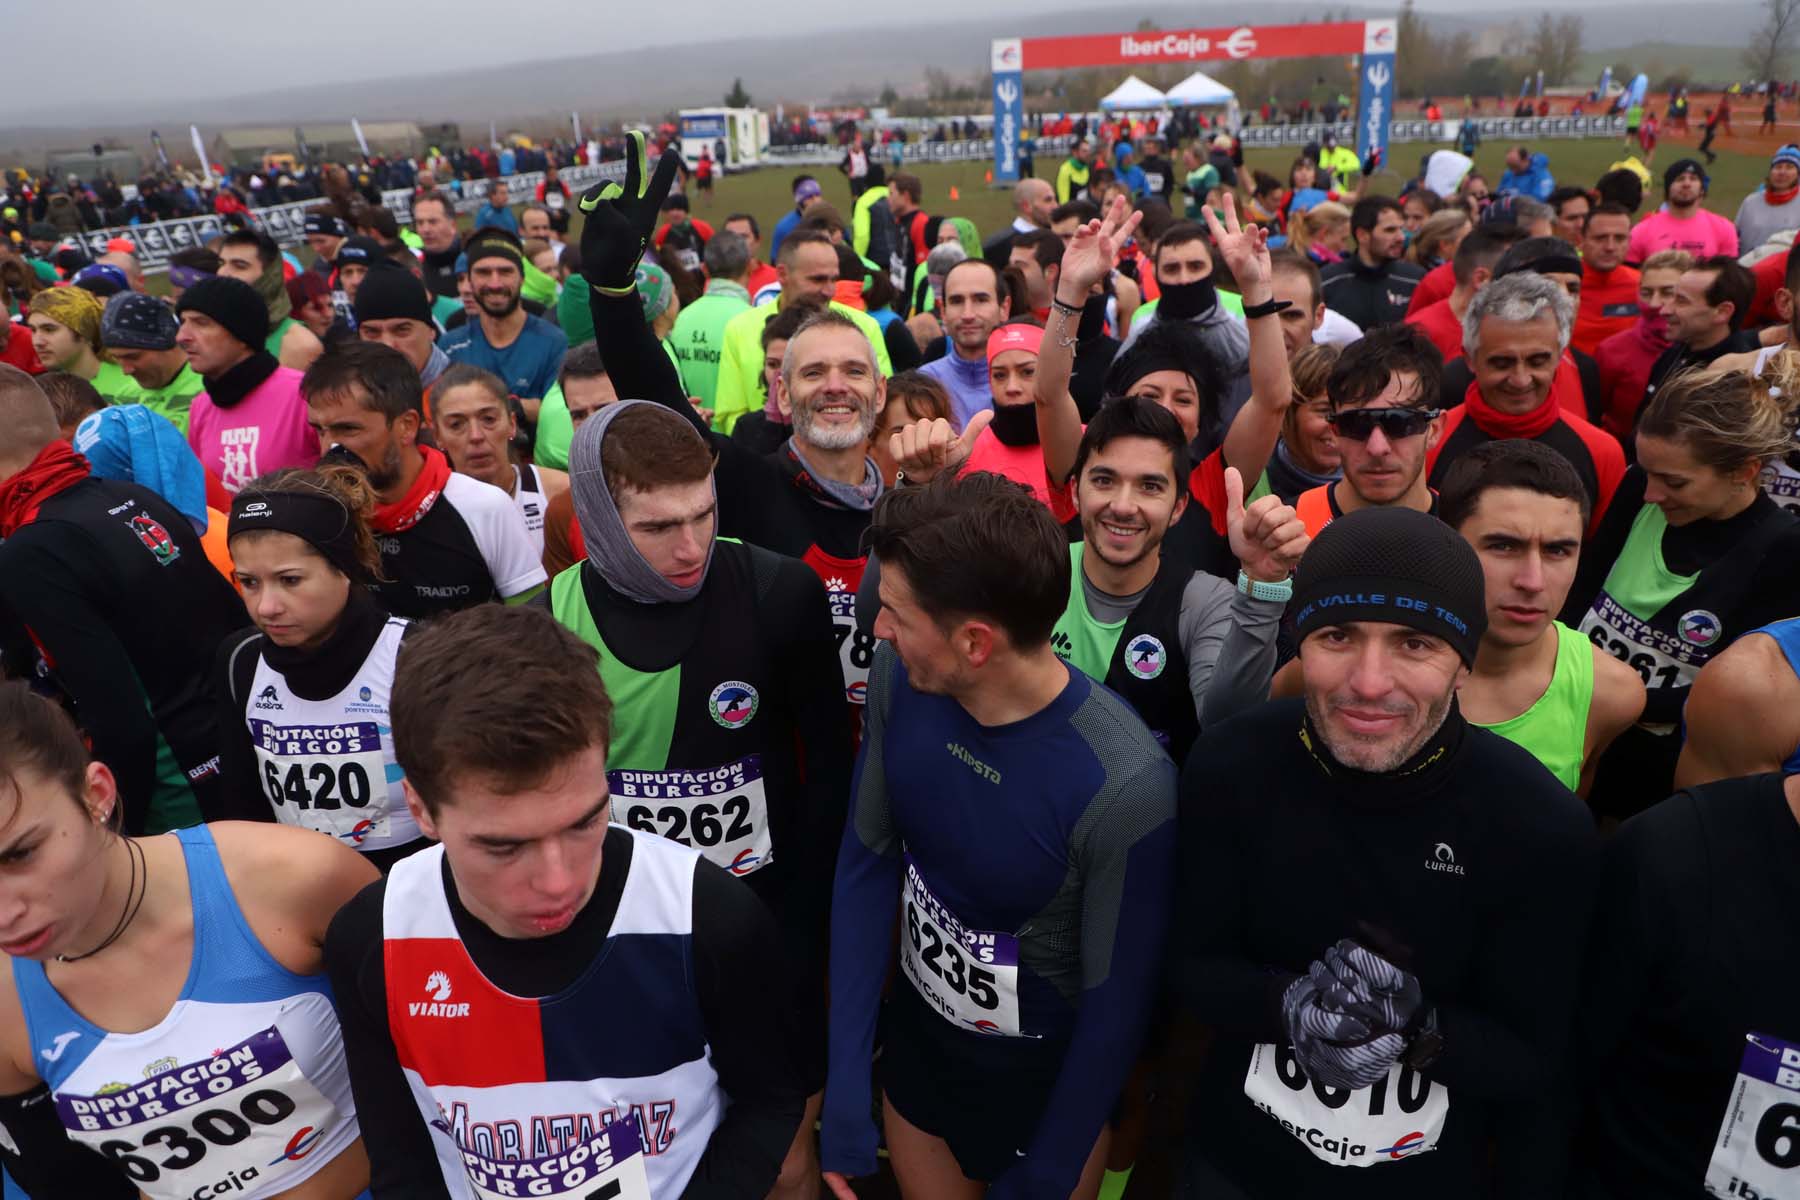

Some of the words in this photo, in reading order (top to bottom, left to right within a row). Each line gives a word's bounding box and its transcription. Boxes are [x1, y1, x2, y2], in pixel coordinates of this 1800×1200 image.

[1120, 33, 1209, 58] iberCaja
[1318, 594, 1385, 608] VALLE
[1394, 597, 1428, 613] DE
[1599, 607, 1691, 663] BURGOS
[262, 724, 360, 741] DIPUTACIÓN
[263, 737, 362, 754] BURGOS
[264, 760, 371, 811] 6420
[621, 763, 743, 784] DIPUTACIÓN
[623, 774, 745, 797] BURGOS
[627, 795, 753, 847] 6262
[1425, 860, 1465, 875] LURBEL
[908, 864, 996, 946] DIPUTACIÓN
[908, 901, 999, 1010] 6235
[905, 951, 955, 1017] iberCaja
[408, 1002, 471, 1018] VIATOR
[72, 1045, 255, 1115] DIPUTACIÓN
[77, 1061, 263, 1131] BURGOS
[100, 1089, 296, 1182] 6300
[464, 1132, 612, 1179] PUTACIÓN
[188, 1166, 259, 1200] Caja
[467, 1148, 614, 1197] URGOS
